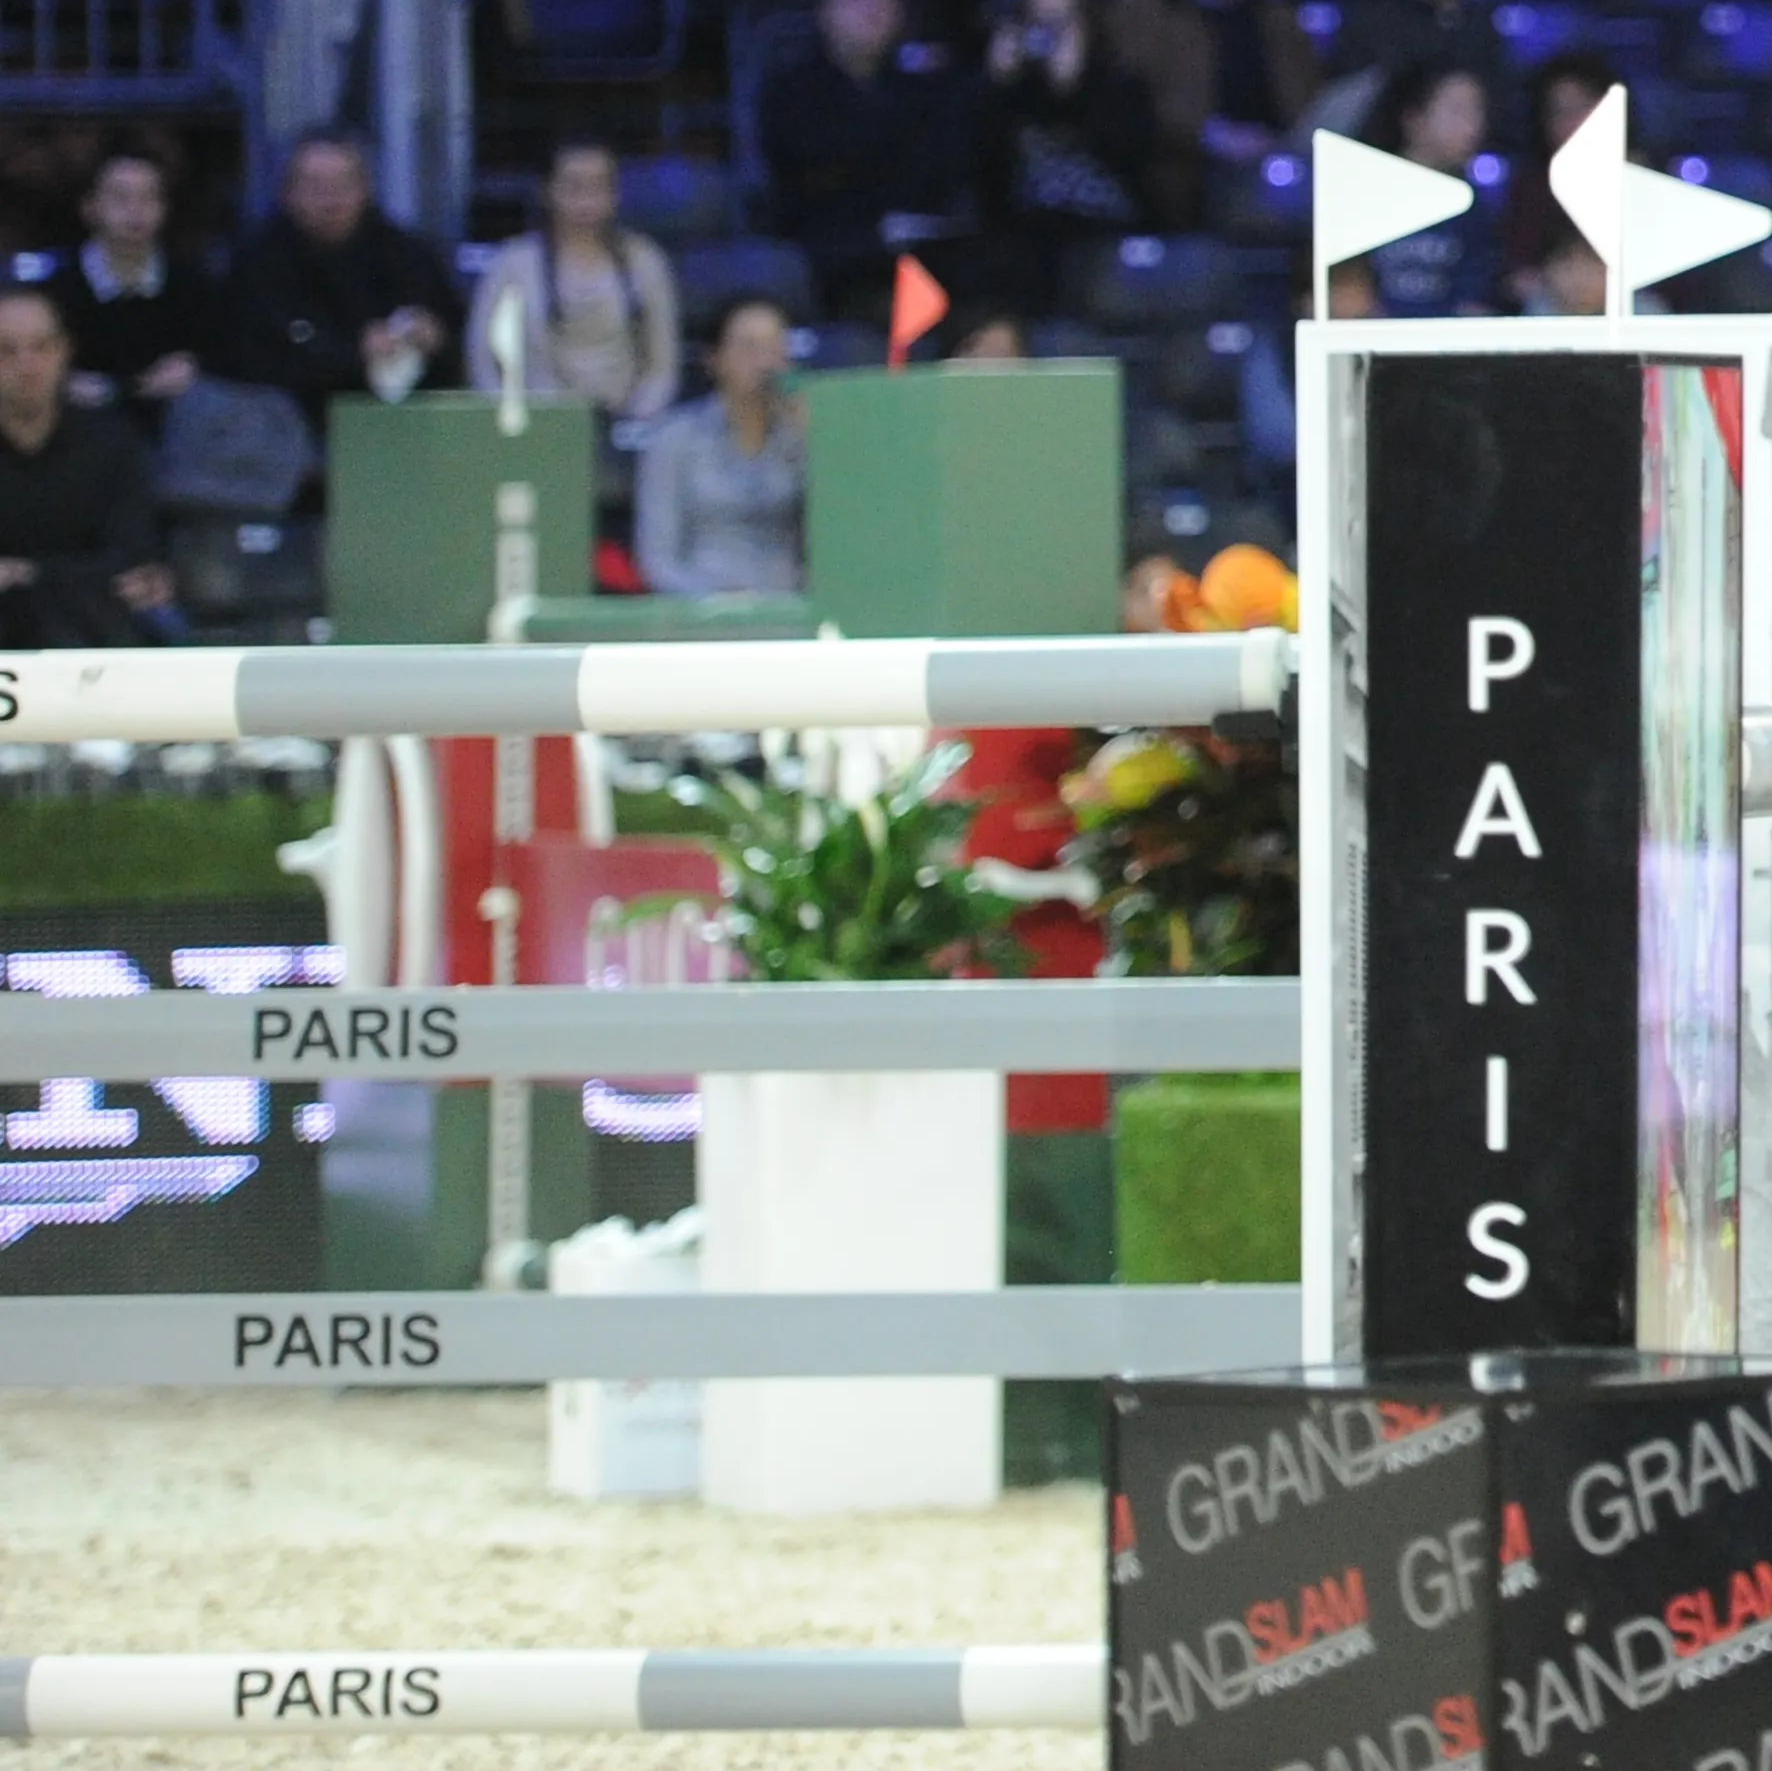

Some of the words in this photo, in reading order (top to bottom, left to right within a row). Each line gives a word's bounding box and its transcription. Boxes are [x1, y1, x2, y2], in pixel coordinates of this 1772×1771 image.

[1454, 615, 1542, 1300] PARIS
[252, 1007, 459, 1060] PARIS
[234, 1314, 441, 1367] PARIS
[234, 1668, 441, 1719] PARIS
